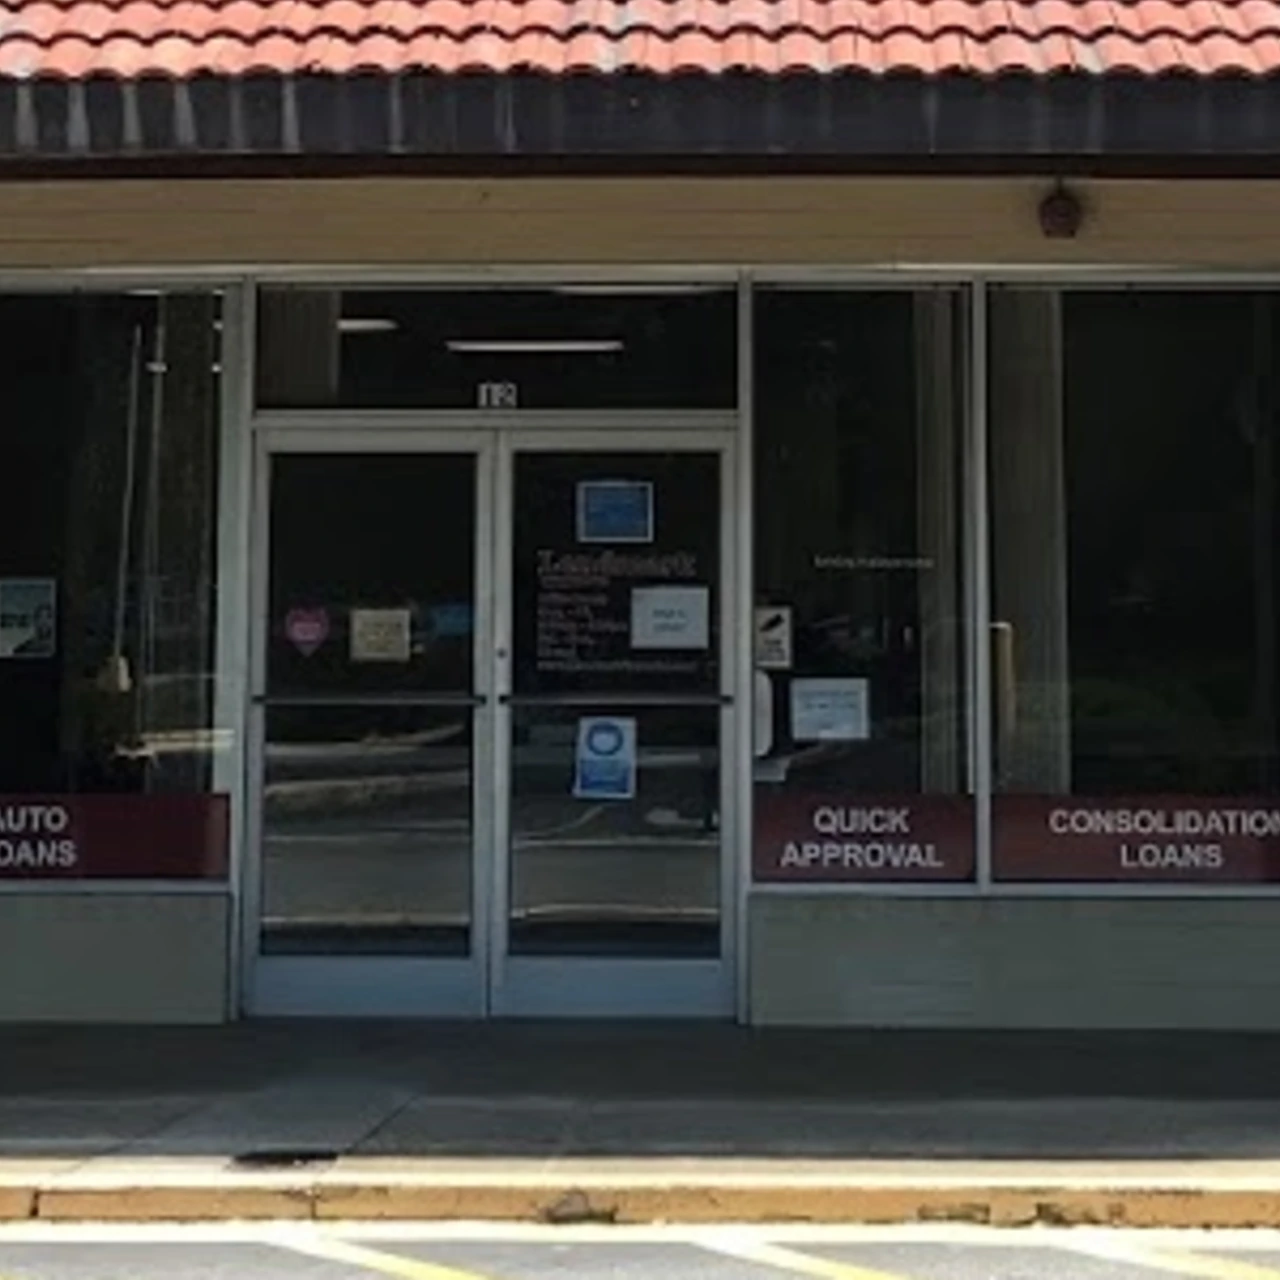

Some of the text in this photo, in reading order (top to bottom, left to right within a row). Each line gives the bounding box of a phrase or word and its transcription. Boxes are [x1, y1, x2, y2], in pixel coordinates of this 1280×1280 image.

[813, 807, 910, 834] QUICK
[780, 842, 943, 868] APPROVAL
[1121, 843, 1222, 869] LOANS
